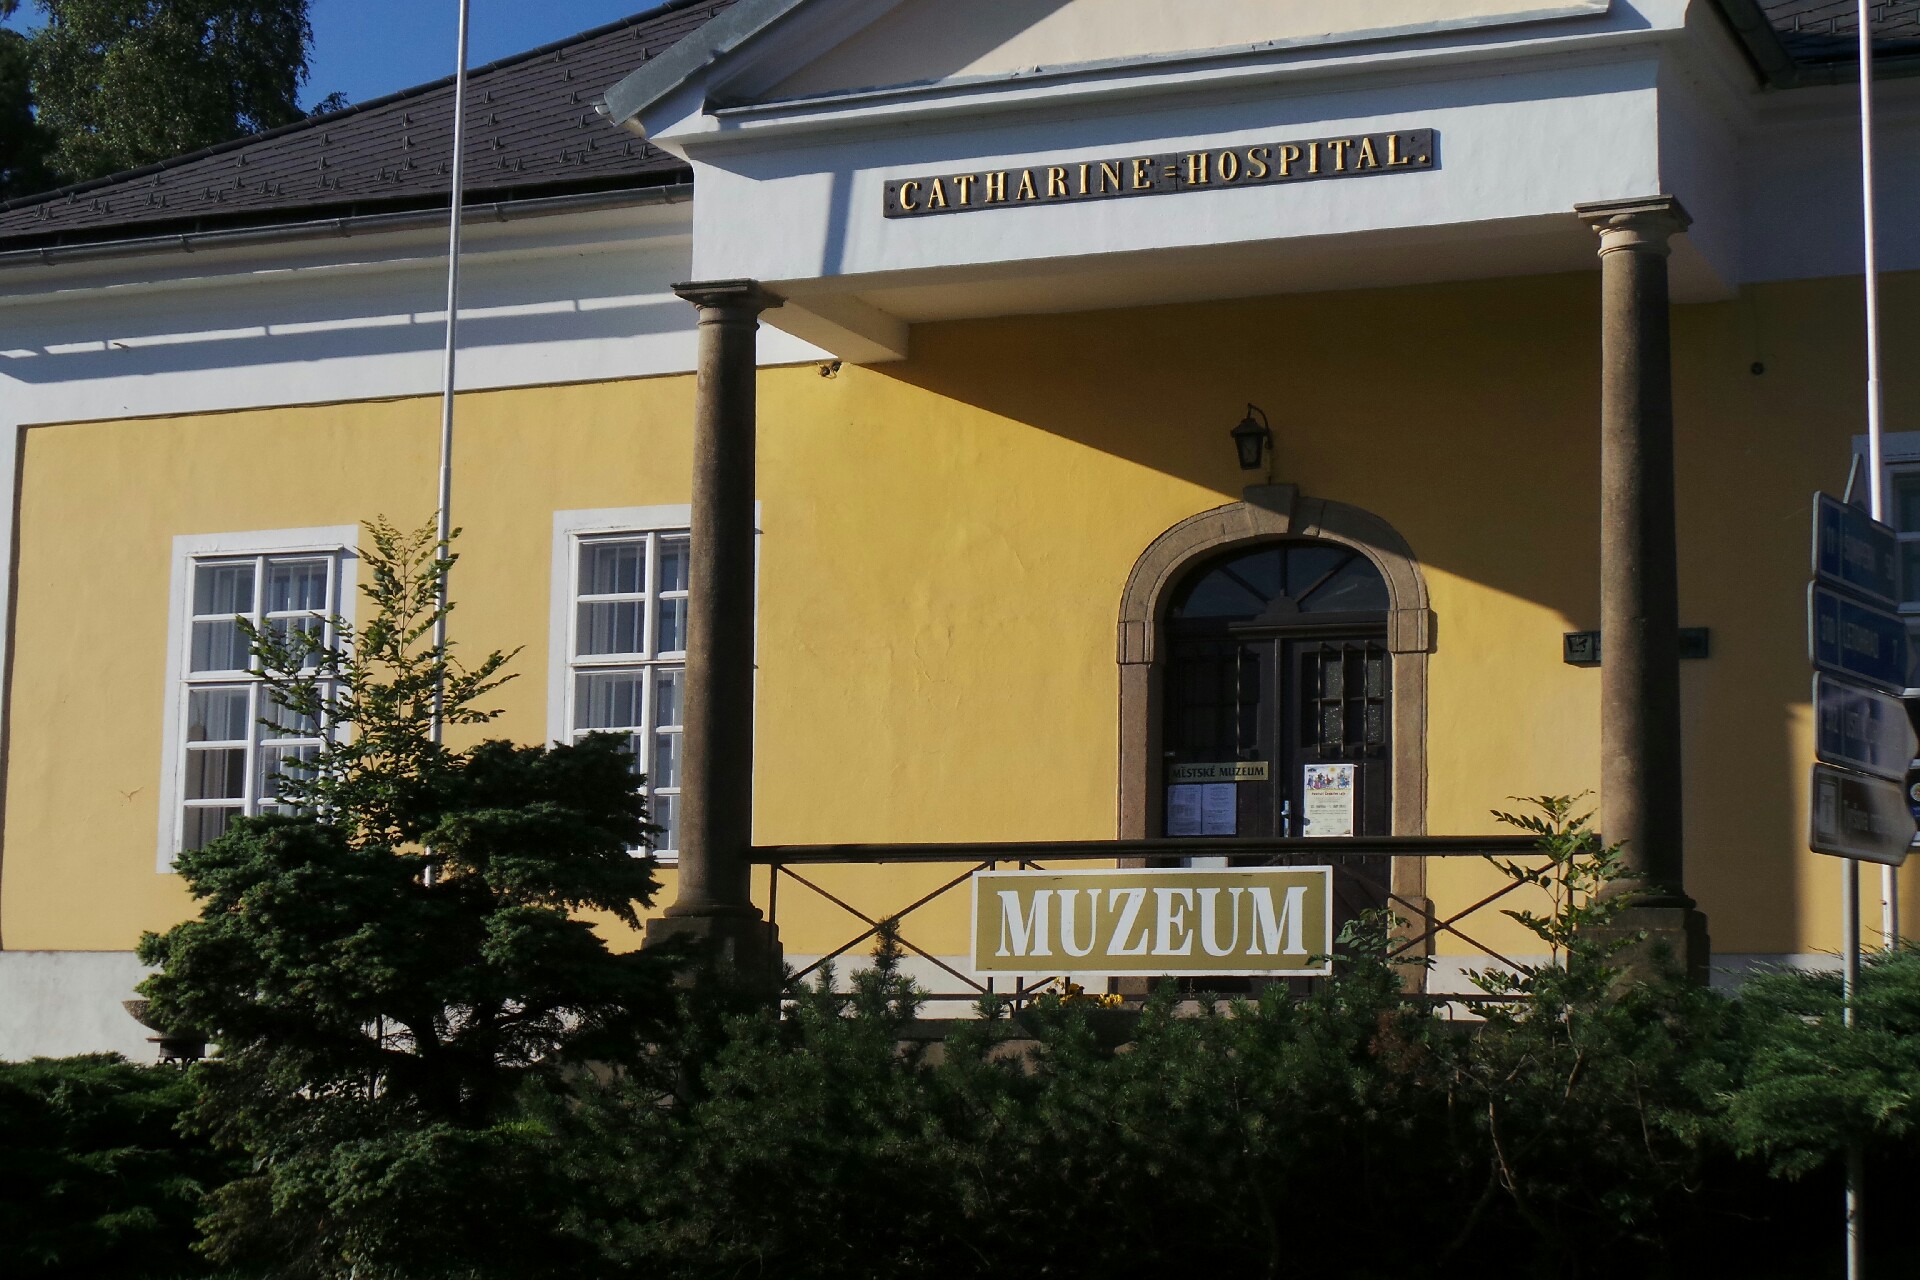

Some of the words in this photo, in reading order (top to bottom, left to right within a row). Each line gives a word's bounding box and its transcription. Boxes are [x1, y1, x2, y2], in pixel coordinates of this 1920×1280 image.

[1173, 766, 1215, 778] MĚSTSKÉ
[1219, 767, 1264, 777] MUZEUM
[994, 886, 1308, 957] MUZEUM
